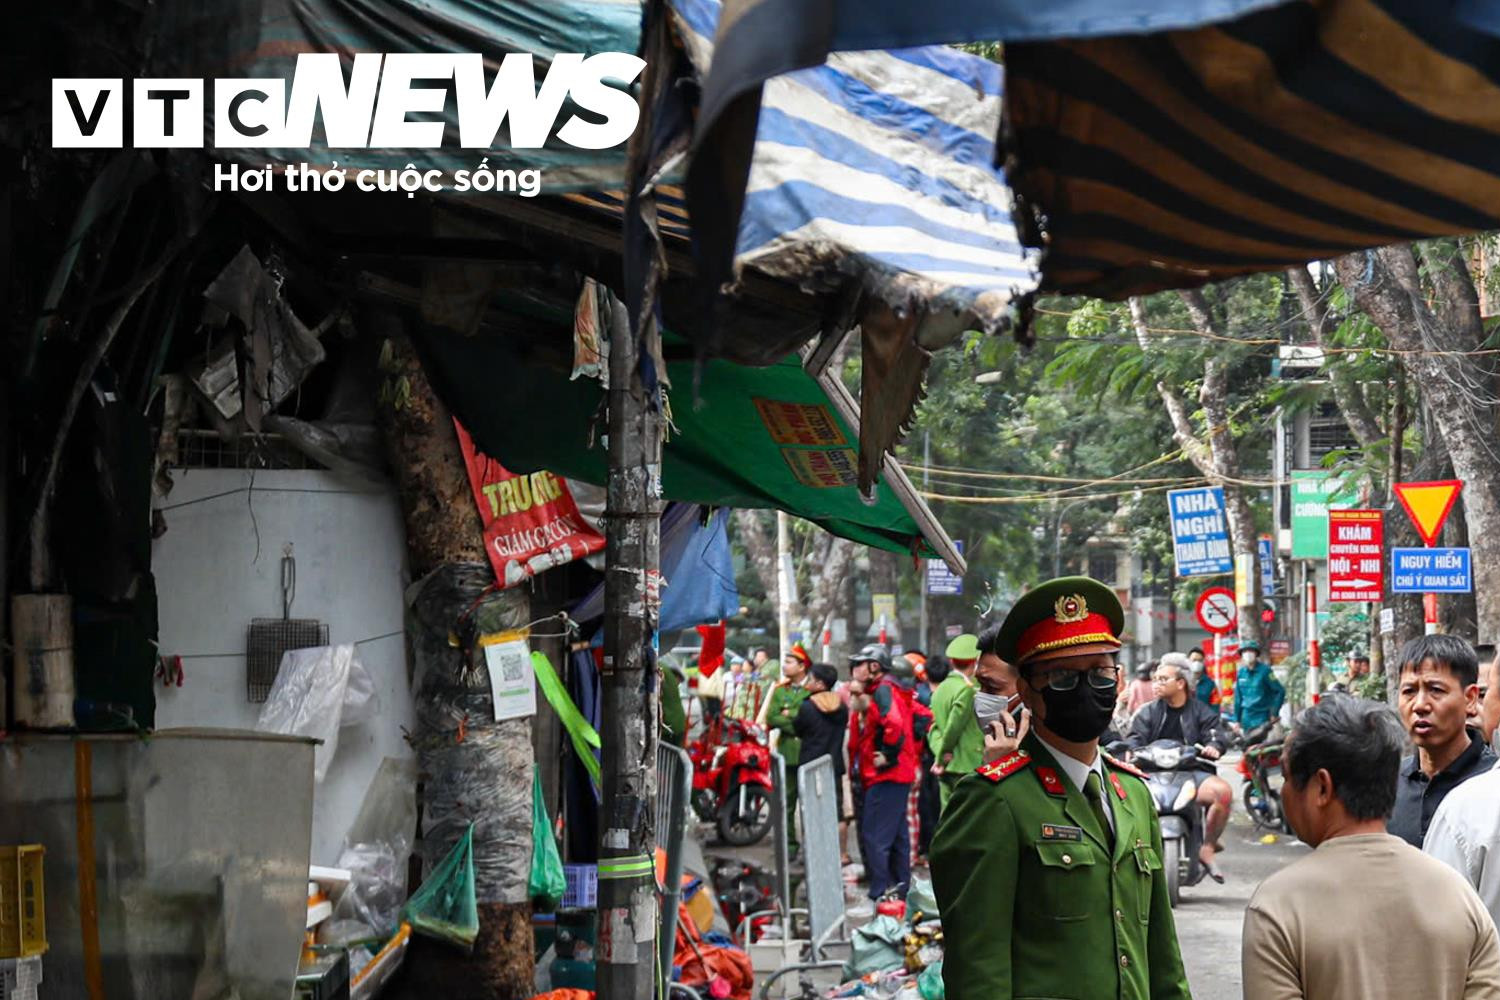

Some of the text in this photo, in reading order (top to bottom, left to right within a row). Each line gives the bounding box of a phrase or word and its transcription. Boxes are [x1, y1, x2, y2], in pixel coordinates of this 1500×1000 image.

[1176, 489, 1219, 513] NHÀ
[1176, 509, 1224, 537] NGHỈ
[1338, 523, 1372, 541] KHÁM
[1330, 556, 1351, 577] NỘI
[1360, 559, 1380, 574] NHI
[1400, 550, 1462, 569] NGUY HIỂM
[1396, 572, 1466, 587] CHÚ Ý QUAN SÁT
